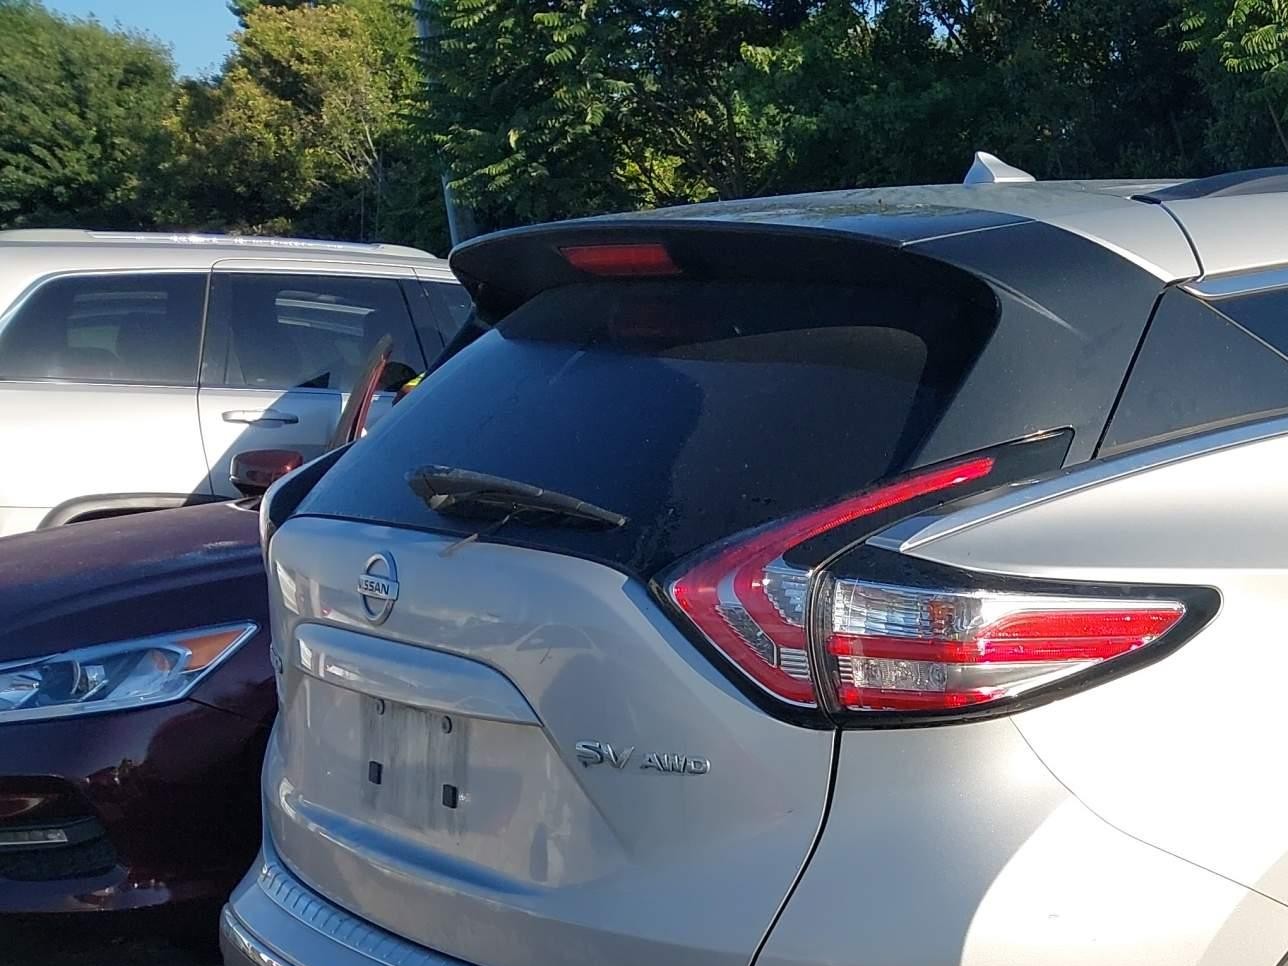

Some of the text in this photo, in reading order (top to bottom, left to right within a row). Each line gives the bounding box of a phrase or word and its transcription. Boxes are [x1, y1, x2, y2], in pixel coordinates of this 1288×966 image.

[358, 579, 390, 595] NSSAN
[575, 739, 712, 775] SV AWD
